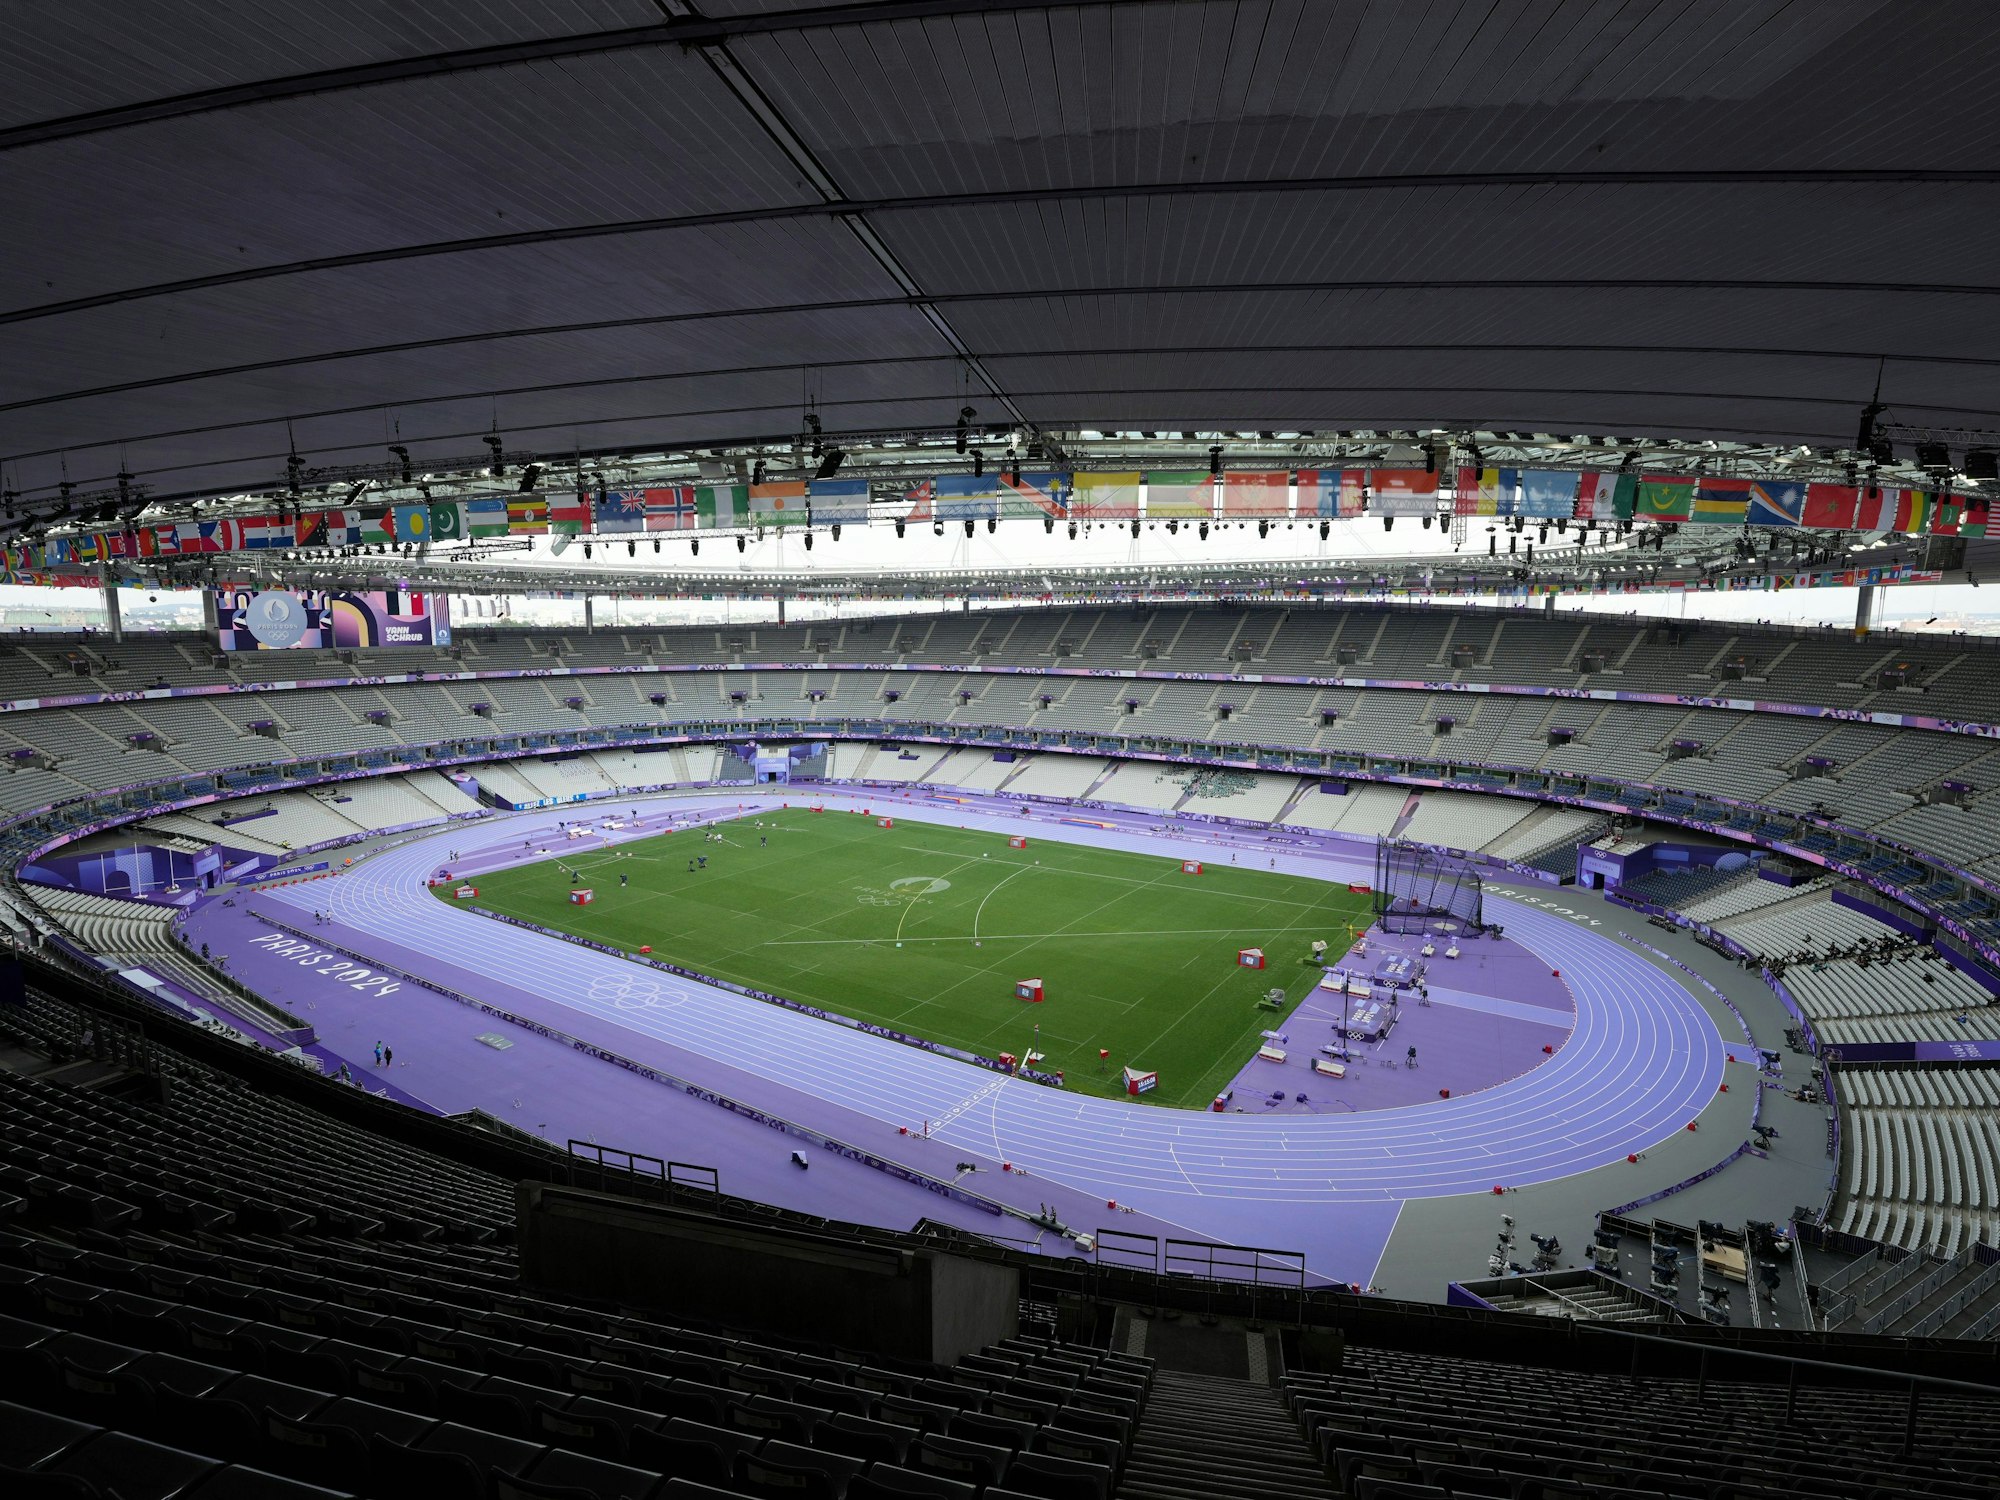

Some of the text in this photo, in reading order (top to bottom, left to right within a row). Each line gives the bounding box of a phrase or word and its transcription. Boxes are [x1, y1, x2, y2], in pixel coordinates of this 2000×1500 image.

[386, 626, 410, 634] YANN
[386, 634, 423, 642] SCHRUB
[326, 840, 340, 848] 2024
[852, 886, 933, 904] PARIS 2024
[1469, 882, 1602, 926] PARIS 2024
[316, 962, 400, 997] 2024
